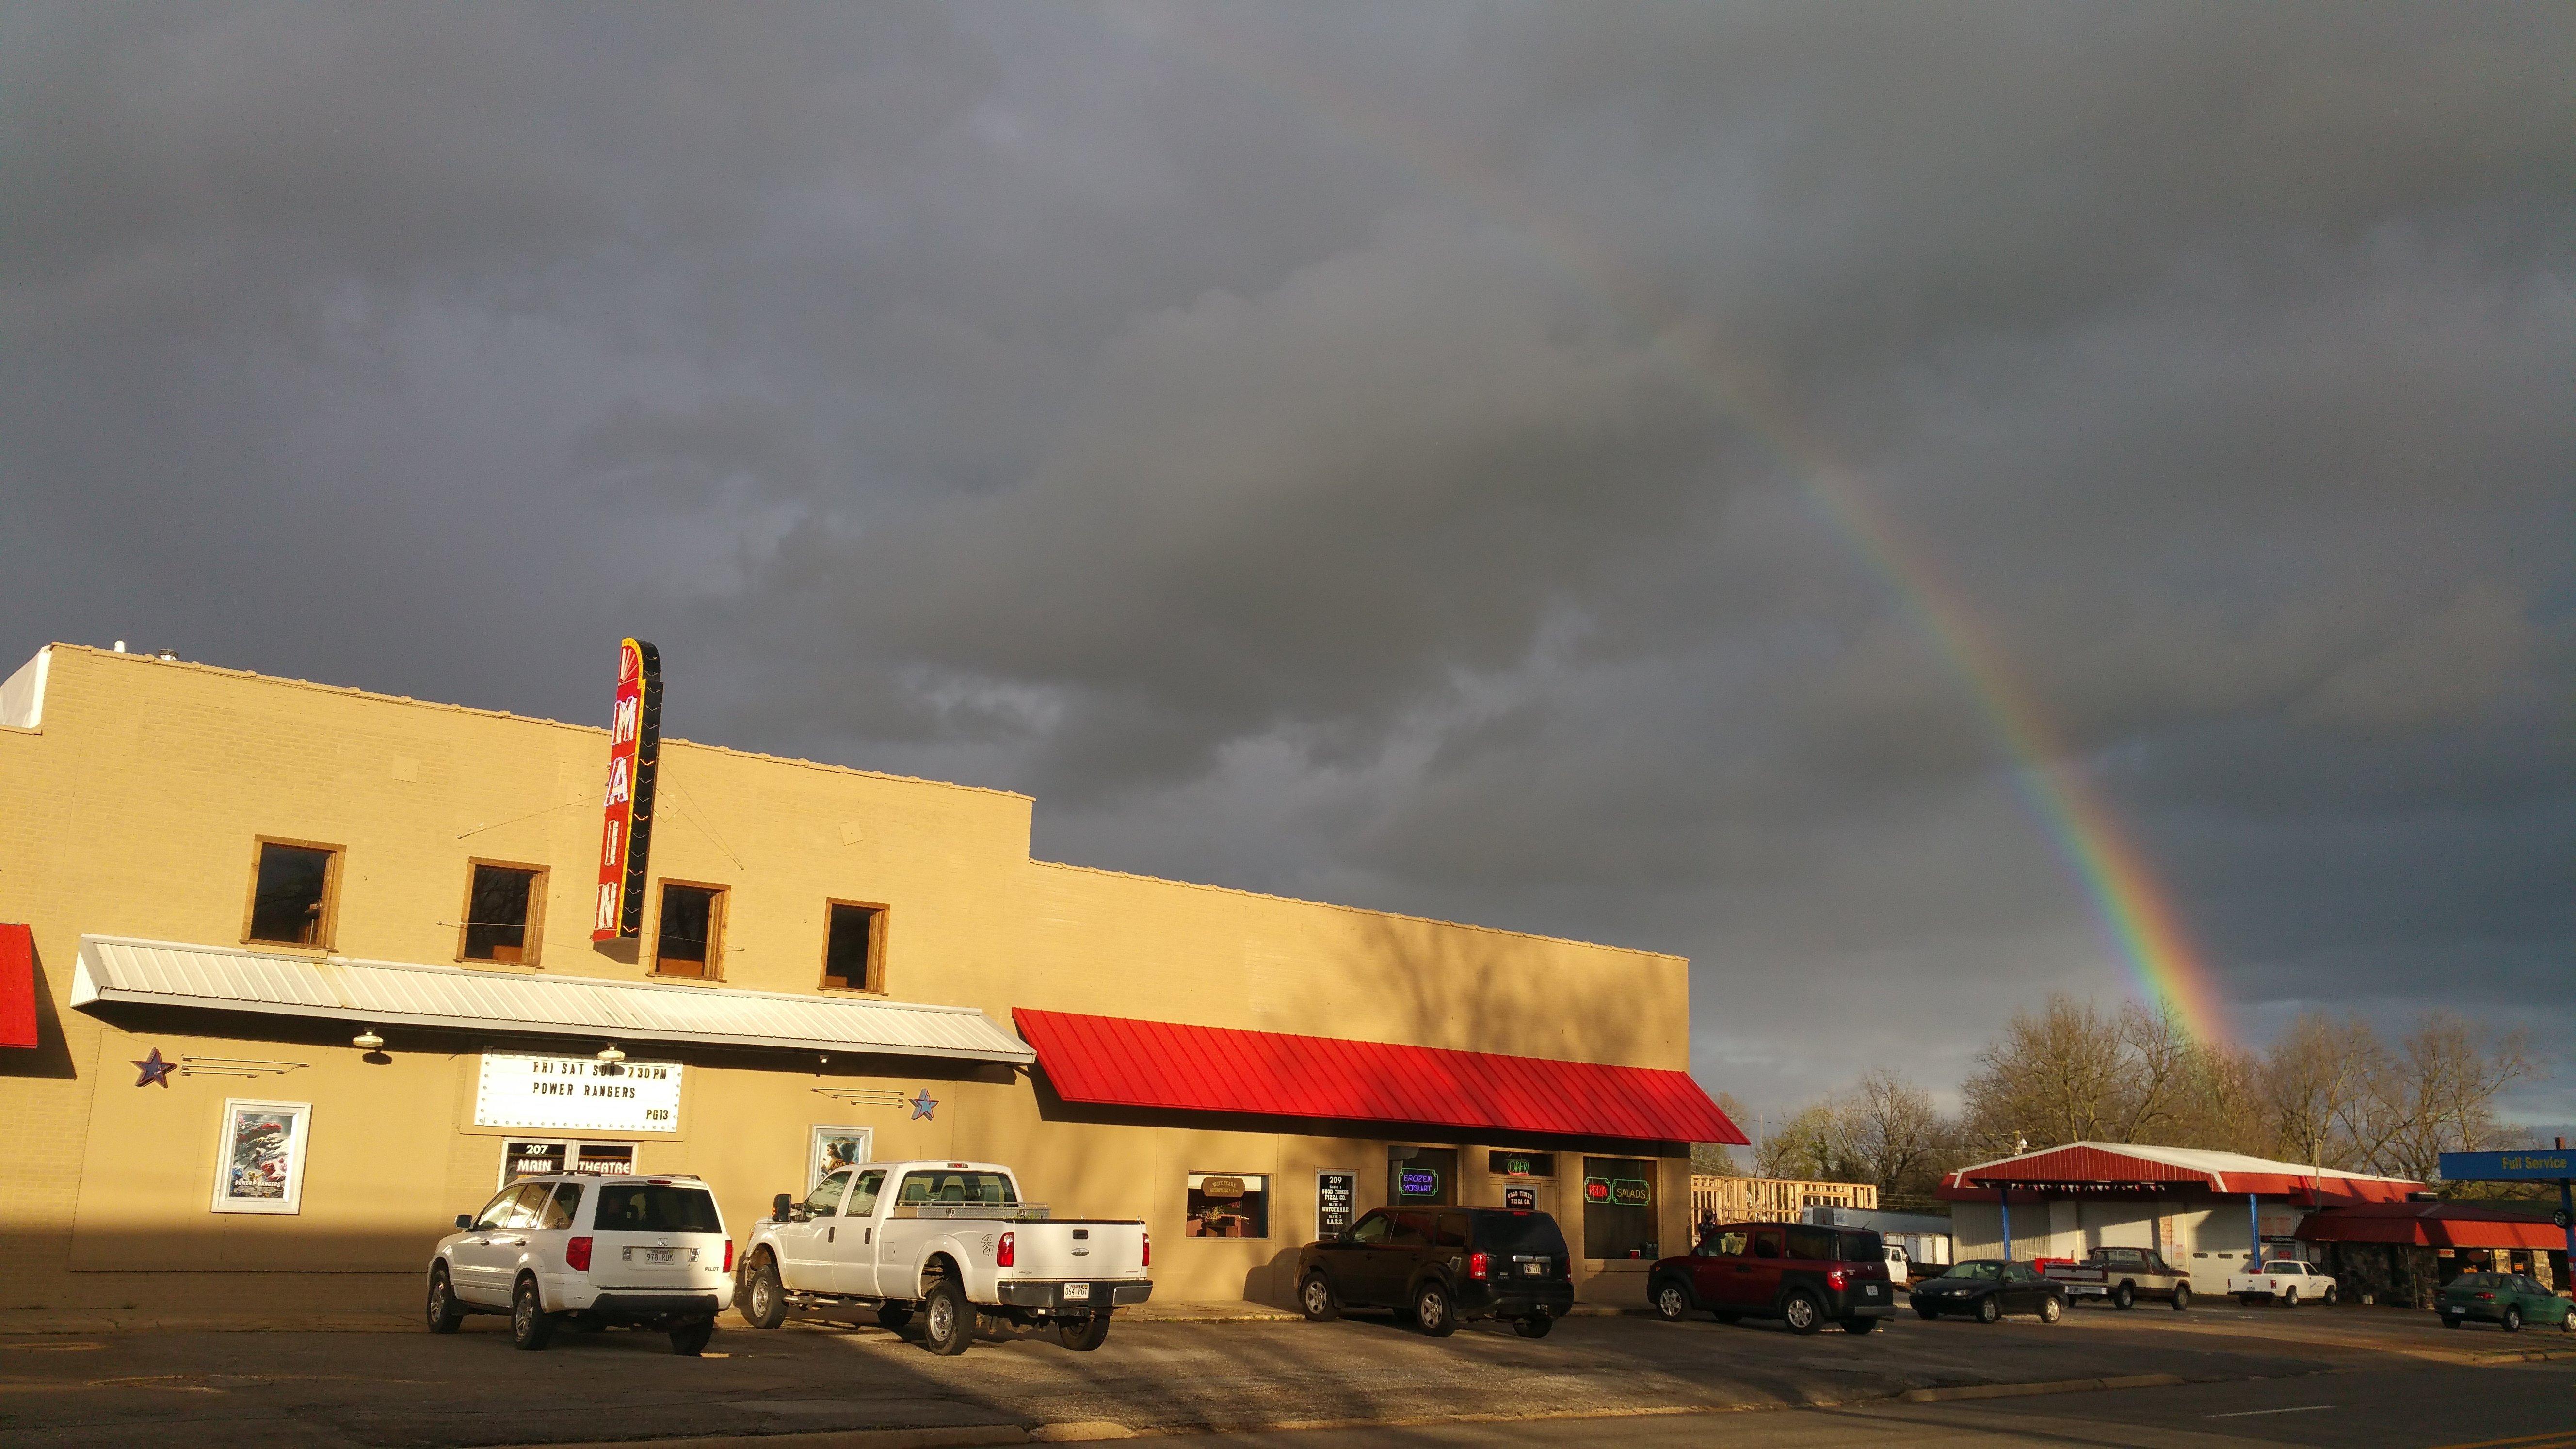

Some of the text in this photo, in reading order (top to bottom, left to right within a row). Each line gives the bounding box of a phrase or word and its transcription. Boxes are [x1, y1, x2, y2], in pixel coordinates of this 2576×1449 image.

[593, 695, 637, 930] MAIN
[533, 1061, 553, 1073] FRI
[561, 1063, 584, 1075] SAT
[592, 1065, 615, 1077] SUN
[532, 1082, 636, 1098] POWER RANGERS
[646, 1109, 669, 1120] PG13
[526, 1144, 548, 1155] 207
[517, 1159, 630, 1175] MAIN THEATRE
[1507, 1160, 1530, 1173] OPEN
[2502, 1156, 2567, 1169] Full Service
[1519, 1191, 1533, 1200] TIMES
[1616, 1188, 1646, 1199] SALADS
[646, 1253, 674, 1262] 978 RDK
[1065, 1288, 1075, 1296] 064
